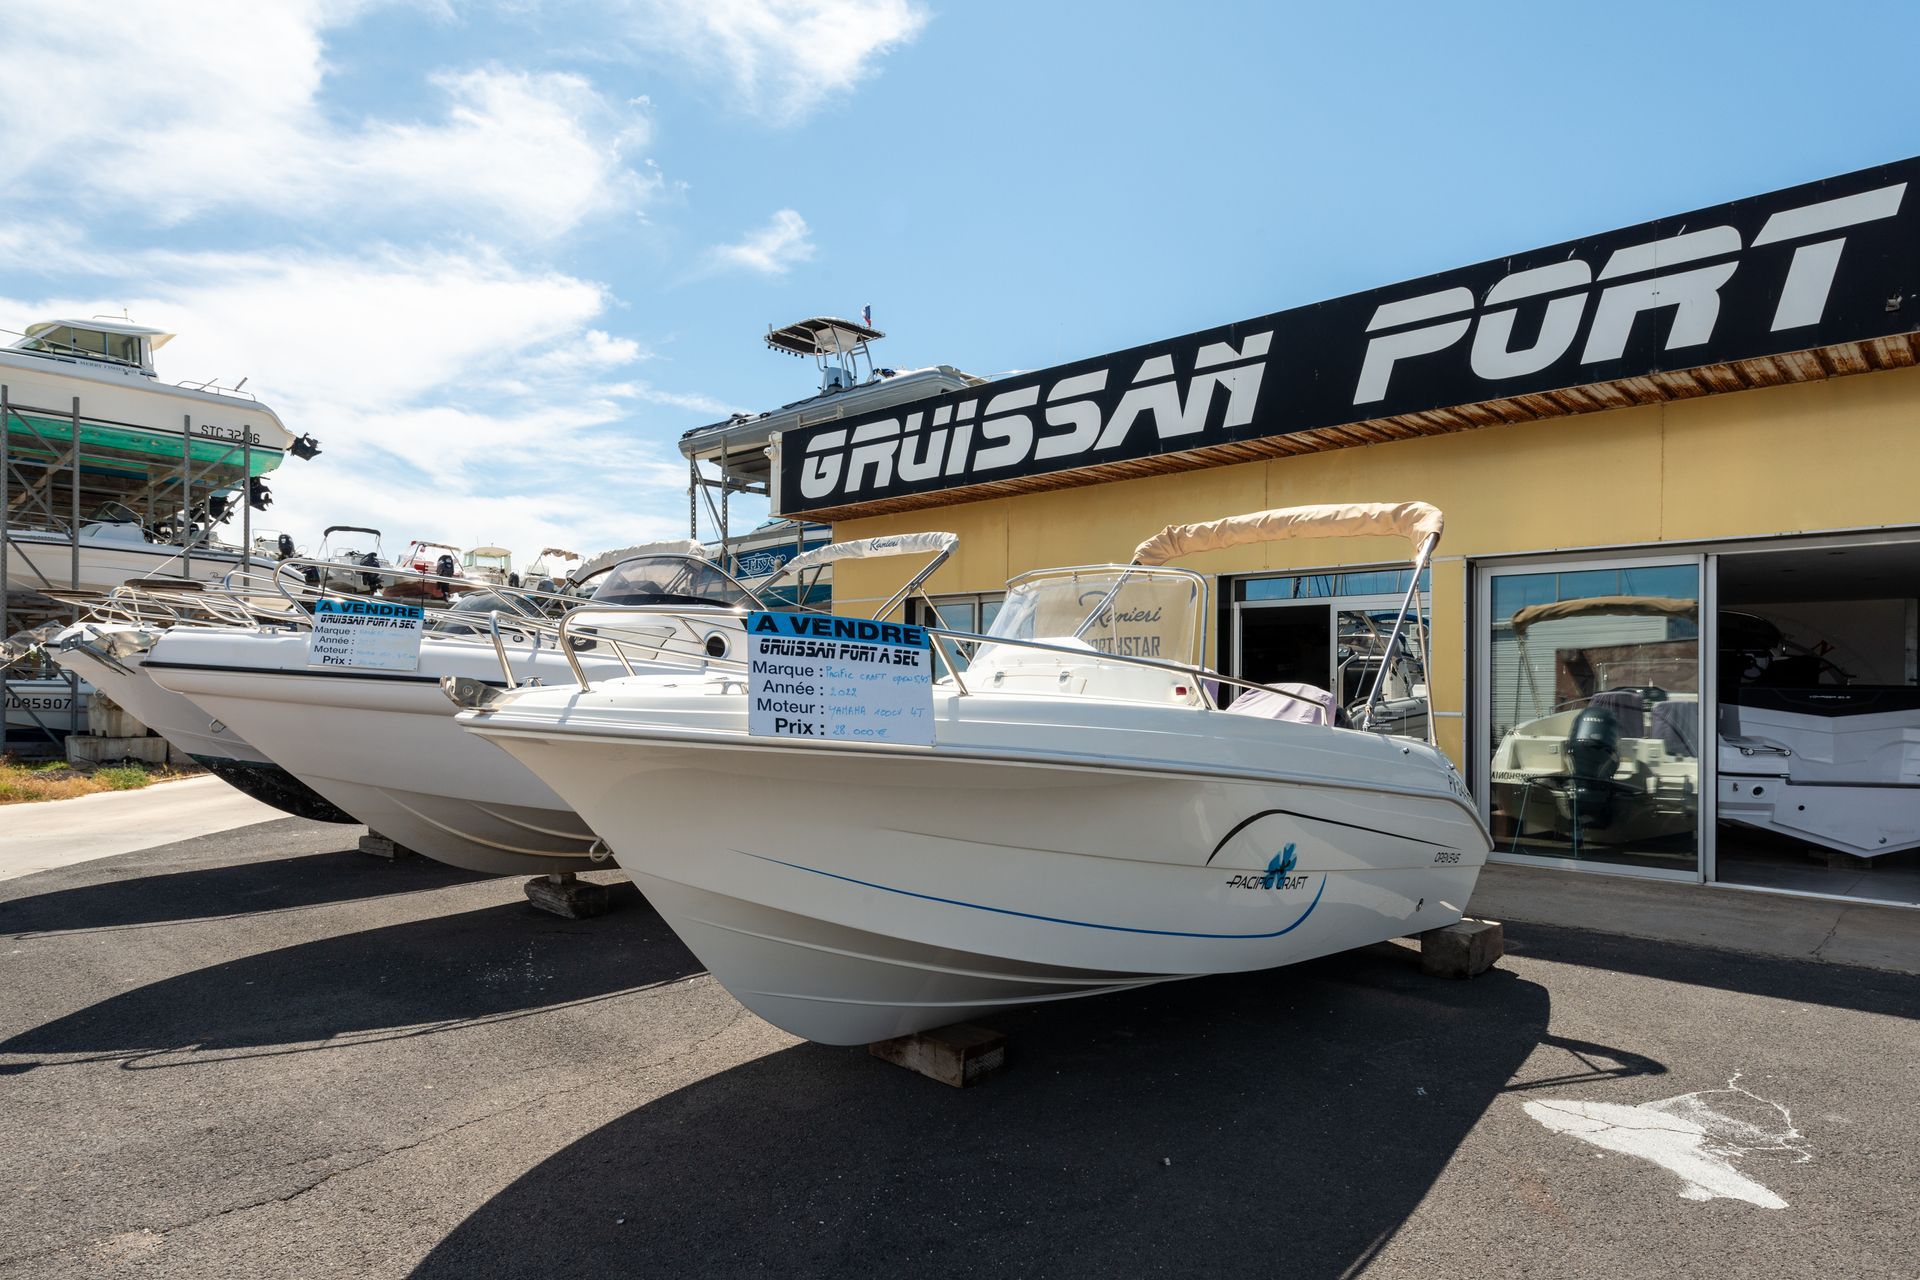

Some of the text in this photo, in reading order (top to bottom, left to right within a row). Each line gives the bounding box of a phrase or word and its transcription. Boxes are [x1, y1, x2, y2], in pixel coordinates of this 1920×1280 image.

[800, 182, 1908, 499] GRUISSAN PORT
[201, 425, 260, 444] STC 326
[320, 602, 420, 618] A VENDRE
[320, 614, 416, 630] GRUISSAN PORT A SEC
[756, 614, 922, 646] A VENDRE
[314, 626, 350, 636] Marque
[319, 636, 349, 644] Année
[1086, 636, 1160, 656] ORTHSTAR
[314, 645, 348, 654] Moteur
[760, 638, 920, 666] GRUISSAN PORT A SEC
[322, 656, 345, 665] Prix
[752, 660, 814, 678] Marque
[762, 680, 814, 696] Année
[830, 687, 858, 697] 2022
[756, 698, 816, 714] Moteur
[828, 704, 866, 721] YAMAHA
[775, 718, 814, 735] Prix
[1226, 875, 1308, 890] PACIFIC CRAFT
